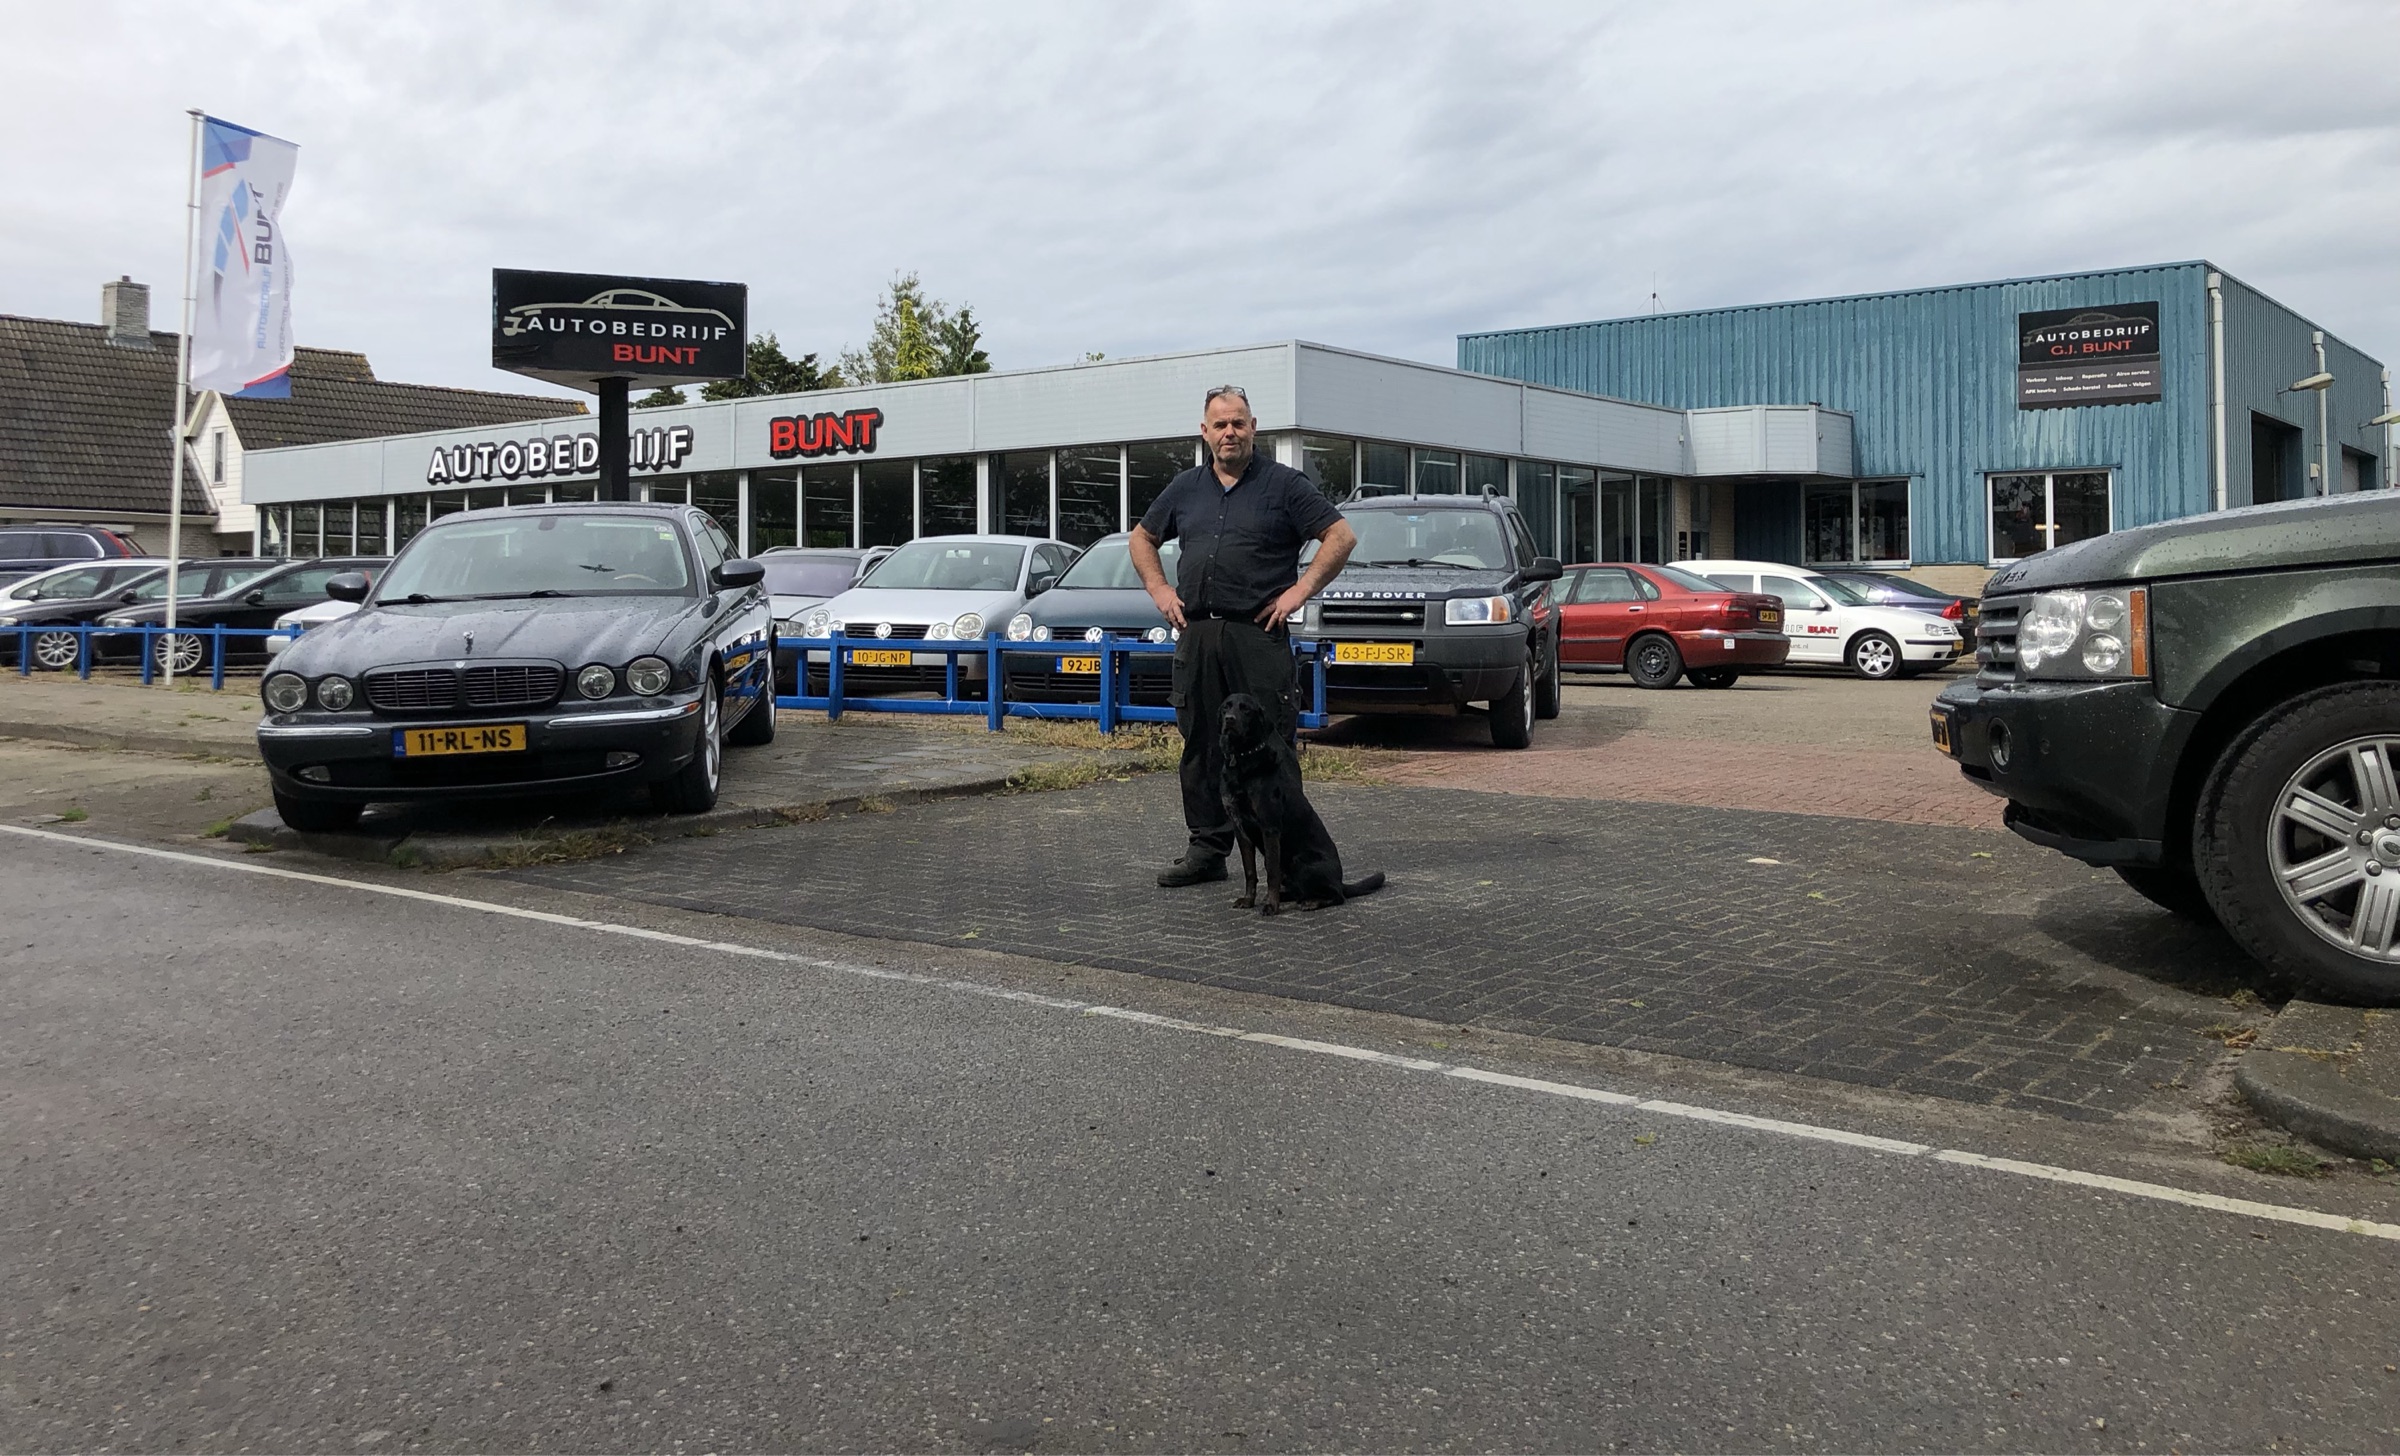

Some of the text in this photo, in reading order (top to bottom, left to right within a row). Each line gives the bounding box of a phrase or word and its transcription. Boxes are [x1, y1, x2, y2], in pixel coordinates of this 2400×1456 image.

[527, 316, 728, 341] AUTOBEDRIJF
[2035, 325, 2150, 343] AUTOBEDRIJF
[613, 343, 700, 365] BUNT
[2050, 339, 2133, 356] G.J. BUNT
[771, 411, 880, 456] BUNT
[427, 427, 690, 481] AUTOBEDIJF
[1322, 591, 1365, 599] LAND
[1807, 625, 1839, 634] BUNT
[857, 651, 907, 663] 10-JG-NP
[1341, 646, 1406, 661] 63-FJ-SR
[1067, 659, 1101, 672] 92-JB
[418, 728, 513, 752] 11-RL-NS
